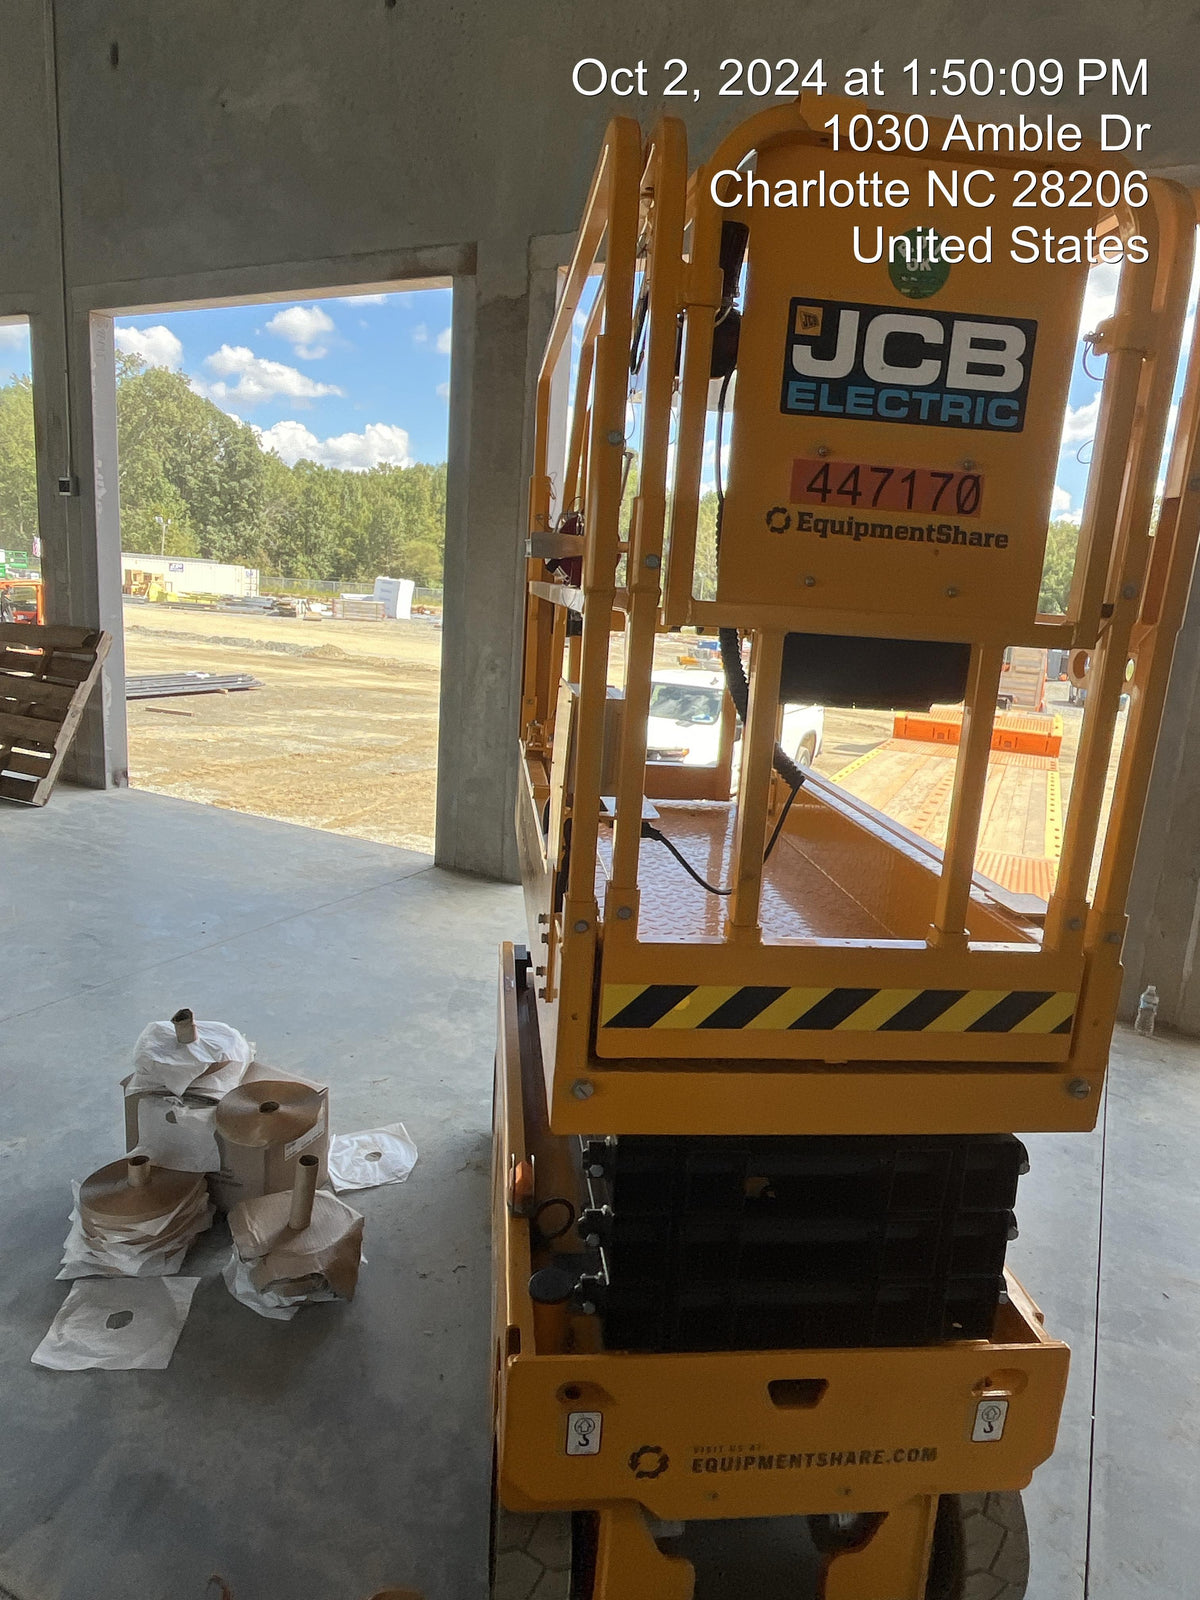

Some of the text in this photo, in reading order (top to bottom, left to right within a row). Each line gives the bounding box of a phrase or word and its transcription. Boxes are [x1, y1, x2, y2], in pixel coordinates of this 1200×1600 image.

[792, 309, 1026, 393] JCB
[787, 380, 1019, 427] ELECTRIC
[806, 462, 982, 515] 447170
[797, 511, 1009, 549] EquipmentShare
[691, 1447, 938, 1473] EQUIPMENTSHARE.COM
